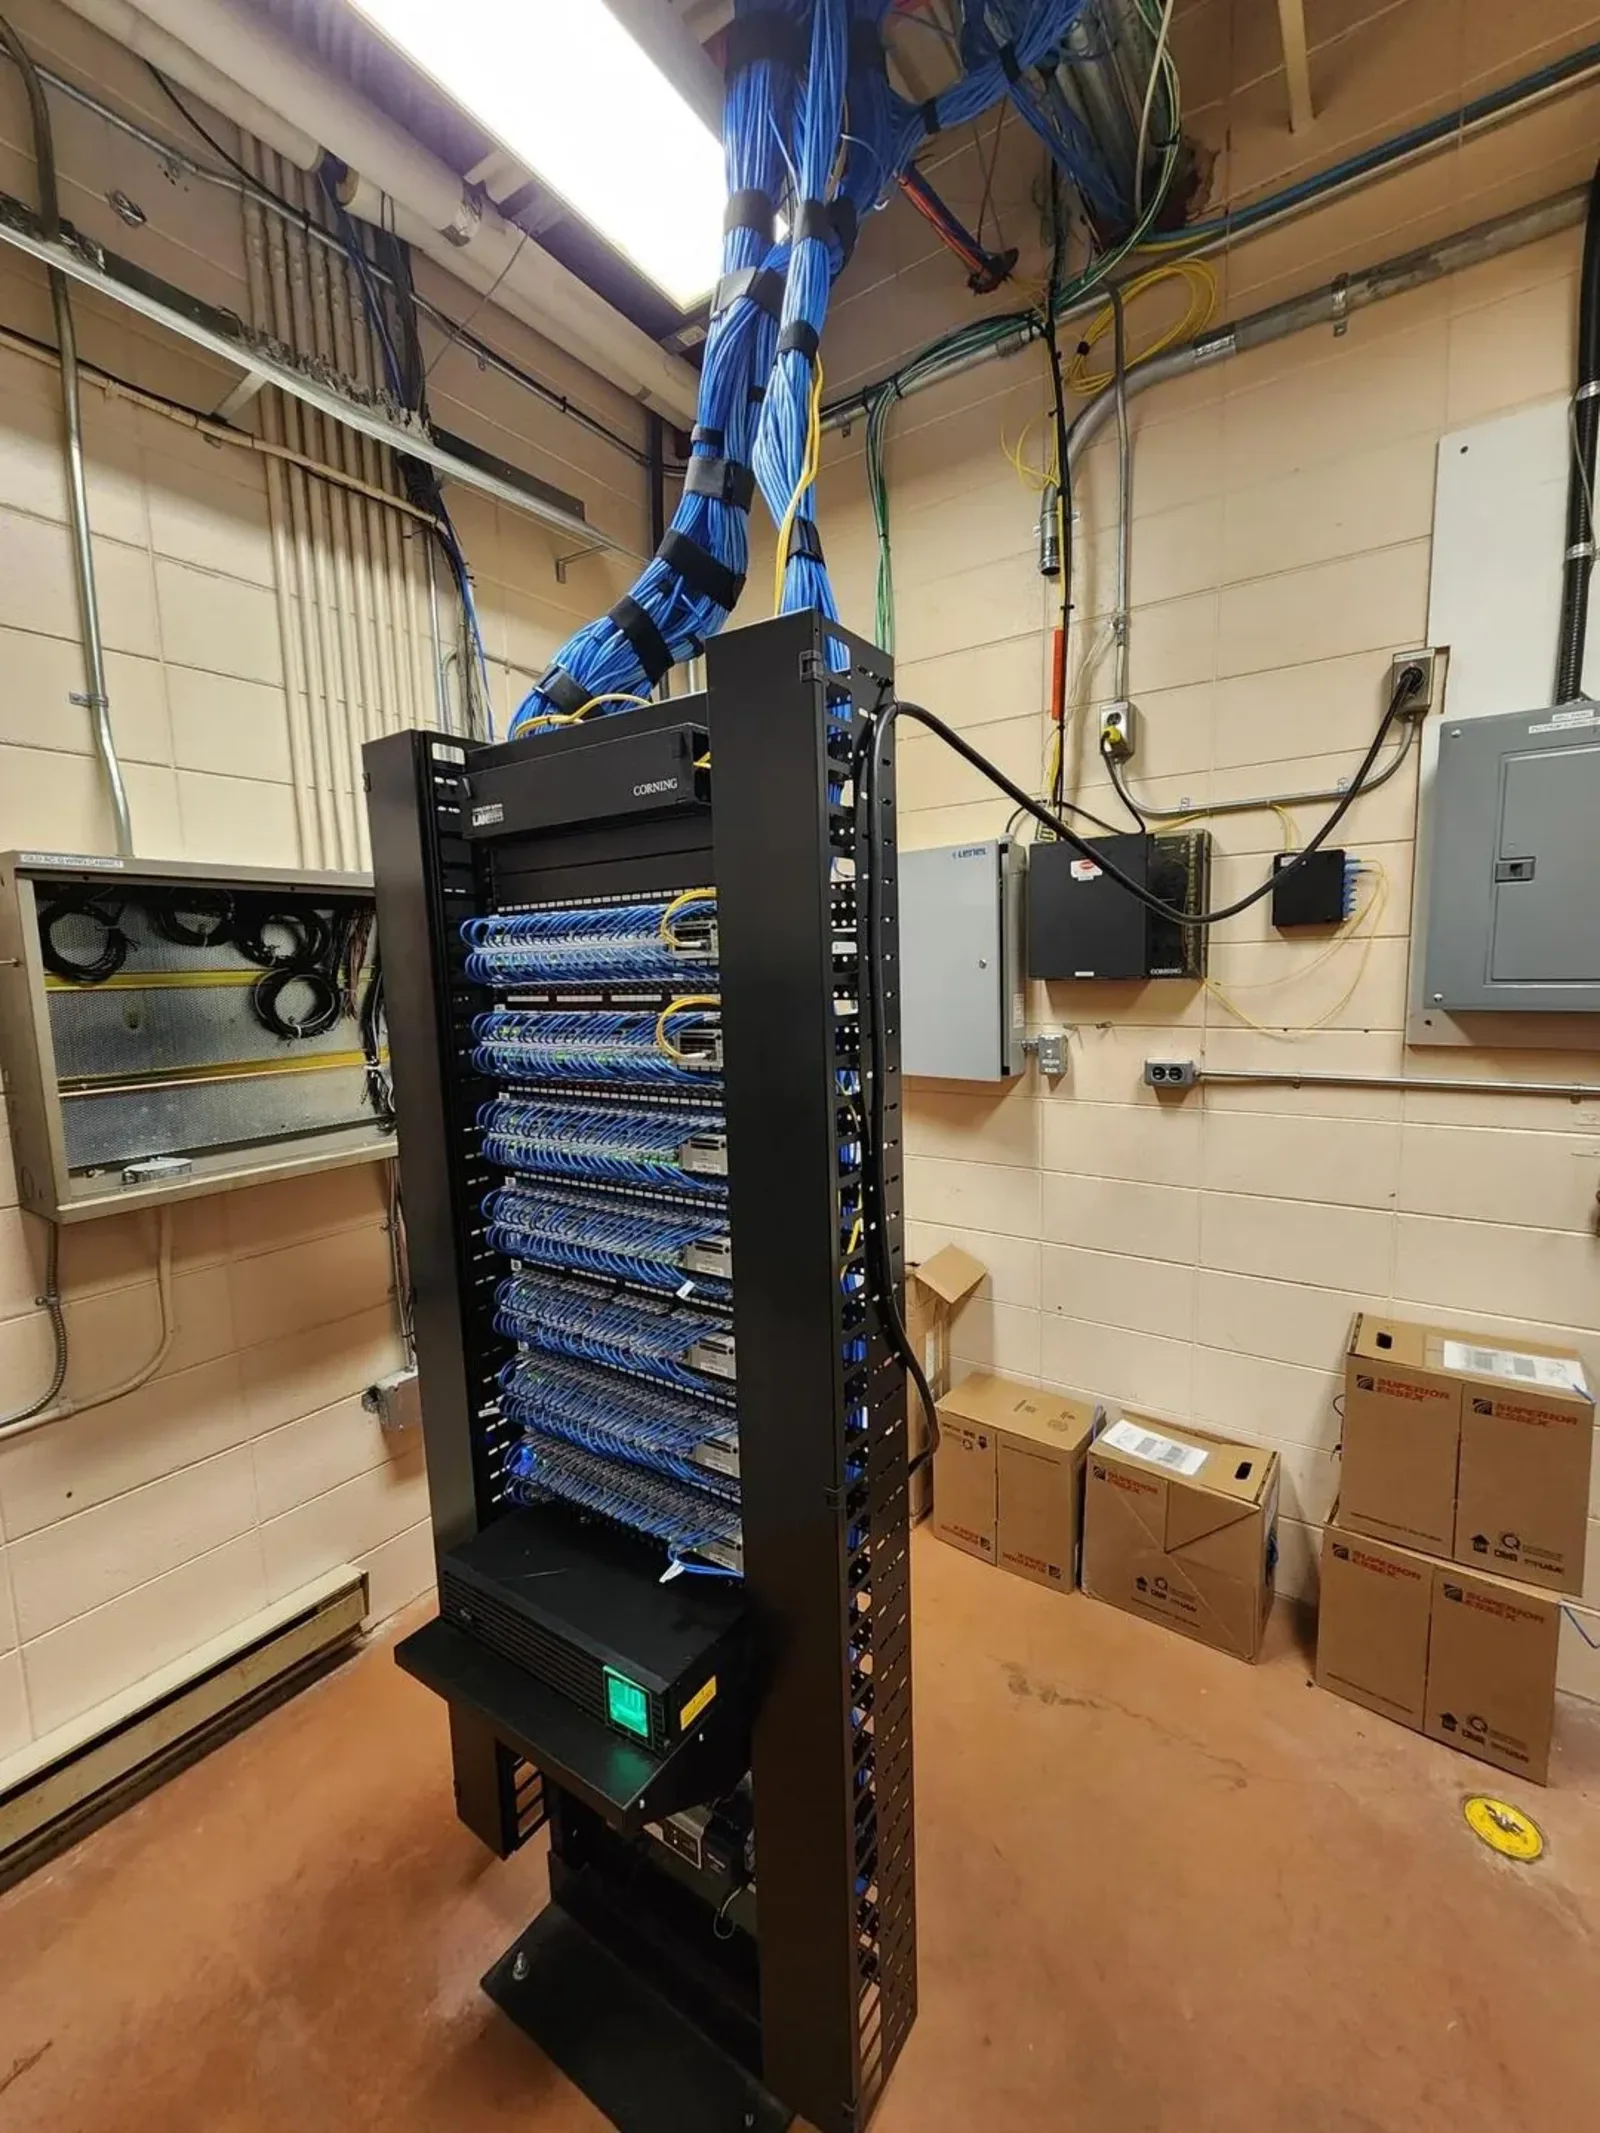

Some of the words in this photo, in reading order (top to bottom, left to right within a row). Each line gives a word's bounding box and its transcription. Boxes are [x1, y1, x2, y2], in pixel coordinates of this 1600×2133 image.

[633, 778, 678, 797] CORNING
[1375, 1385, 1425, 1402] ESSEX
[1376, 1377, 1450, 1400] SUPERIOR
[1495, 1410, 1549, 1428] ESSEX
[1496, 1402, 1578, 1426] SUPERIOR
[1351, 1558, 1401, 1581] ESSEX
[1352, 1550, 1422, 1581] SUPERIOR
[1465, 1591, 1545, 1624] SUPERIOR
